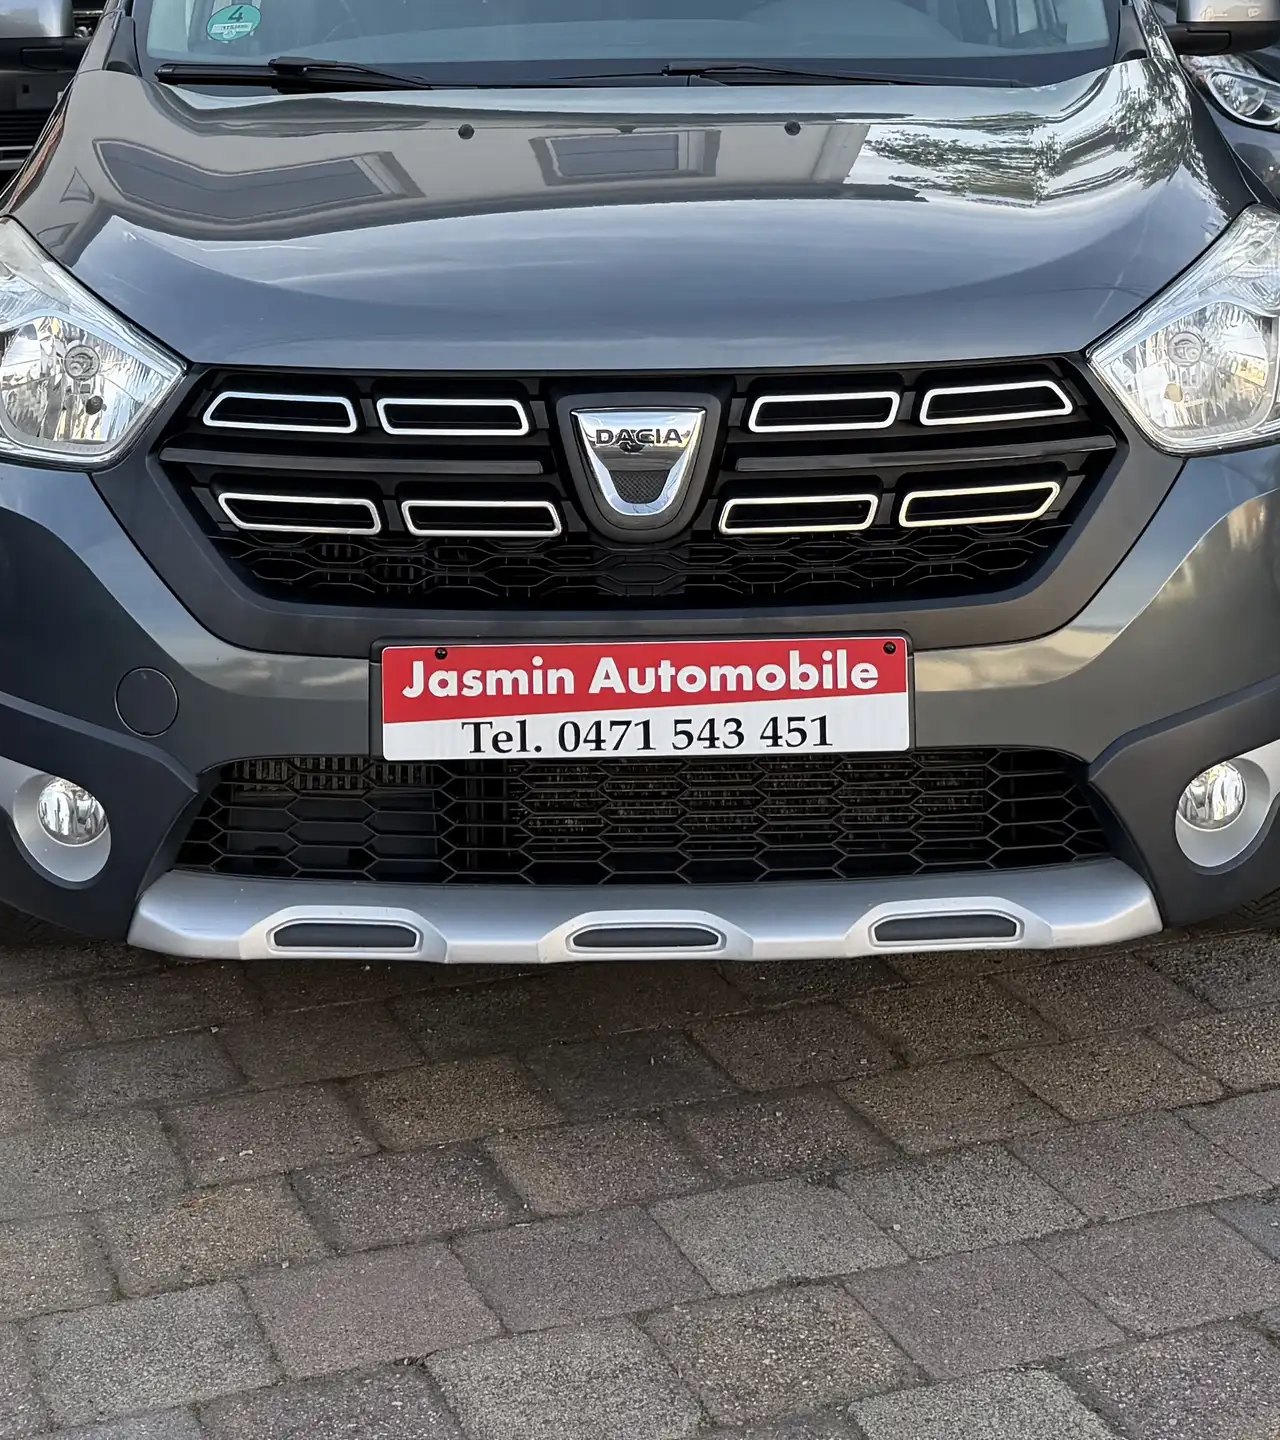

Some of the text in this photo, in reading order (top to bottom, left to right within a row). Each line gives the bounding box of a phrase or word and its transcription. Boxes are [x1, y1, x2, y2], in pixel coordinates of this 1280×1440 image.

[228, 6, 244, 22] 4
[595, 428, 683, 445] DACIA
[401, 649, 879, 698] Jasmin Automobile
[461, 714, 834, 754] Tel. 0471 543 451
